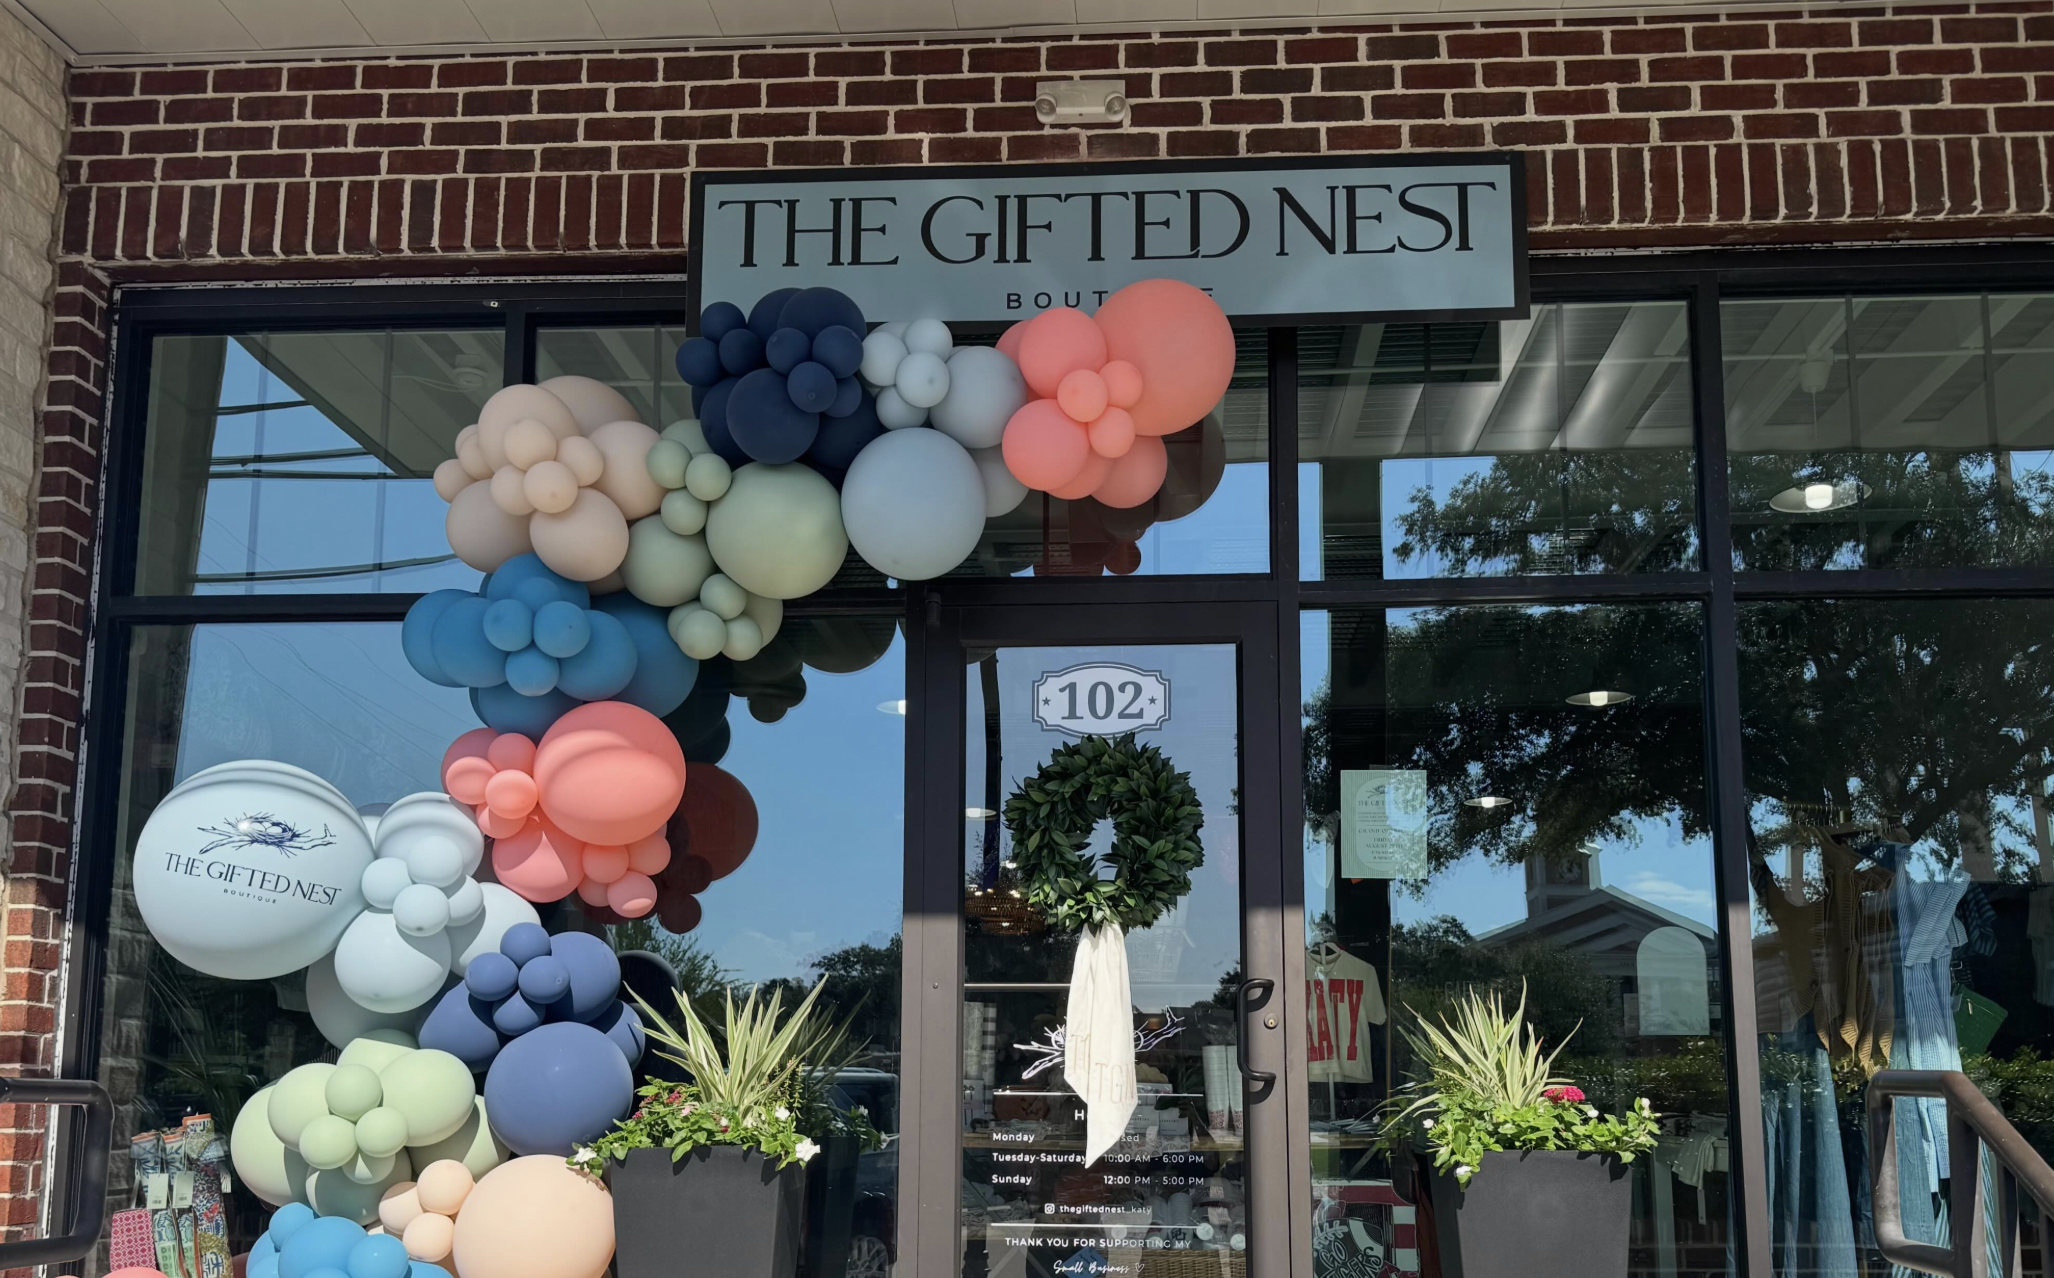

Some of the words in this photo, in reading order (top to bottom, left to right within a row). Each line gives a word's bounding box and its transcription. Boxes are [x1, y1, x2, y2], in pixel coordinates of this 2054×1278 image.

[717, 196, 900, 268] THE
[920, 188, 1251, 266] GIFTED
[1275, 181, 1498, 257] NEST
[1058, 681, 1144, 720] 102
[165, 852, 202, 877] THE
[206, 861, 291, 894] GIFTED
[292, 879, 342, 906] NEST
[223, 888, 278, 904] BOUTIQUE
[992, 1132, 1035, 1143] Monday
[992, 1152, 1087, 1165] Tuesday-Saturday
[1103, 1154, 1131, 1163] 10:00
[1134, 1154, 1151, 1163] AM
[1162, 1154, 1185, 1164] 6:00
[1188, 1154, 1205, 1164] PM
[991, 1174, 1033, 1186] Sunday
[1103, 1175, 1131, 1185] 12:00
[1134, 1176, 1151, 1185] PM
[1162, 1176, 1185, 1185] 5:00
[1188, 1176, 1205, 1186] PM
[1059, 1204, 1152, 1215] thegiftednest_katy
[1005, 1237, 1043, 1247] THANK
[1047, 1238, 1069, 1247] YOU
[1073, 1238, 1096, 1247] FOR
[1099, 1238, 1171, 1248] SUPPORTING
[1175, 1239, 1191, 1249] MY
[1053, 1259, 1084, 1274] Small
[1088, 1261, 1130, 1274] Business
